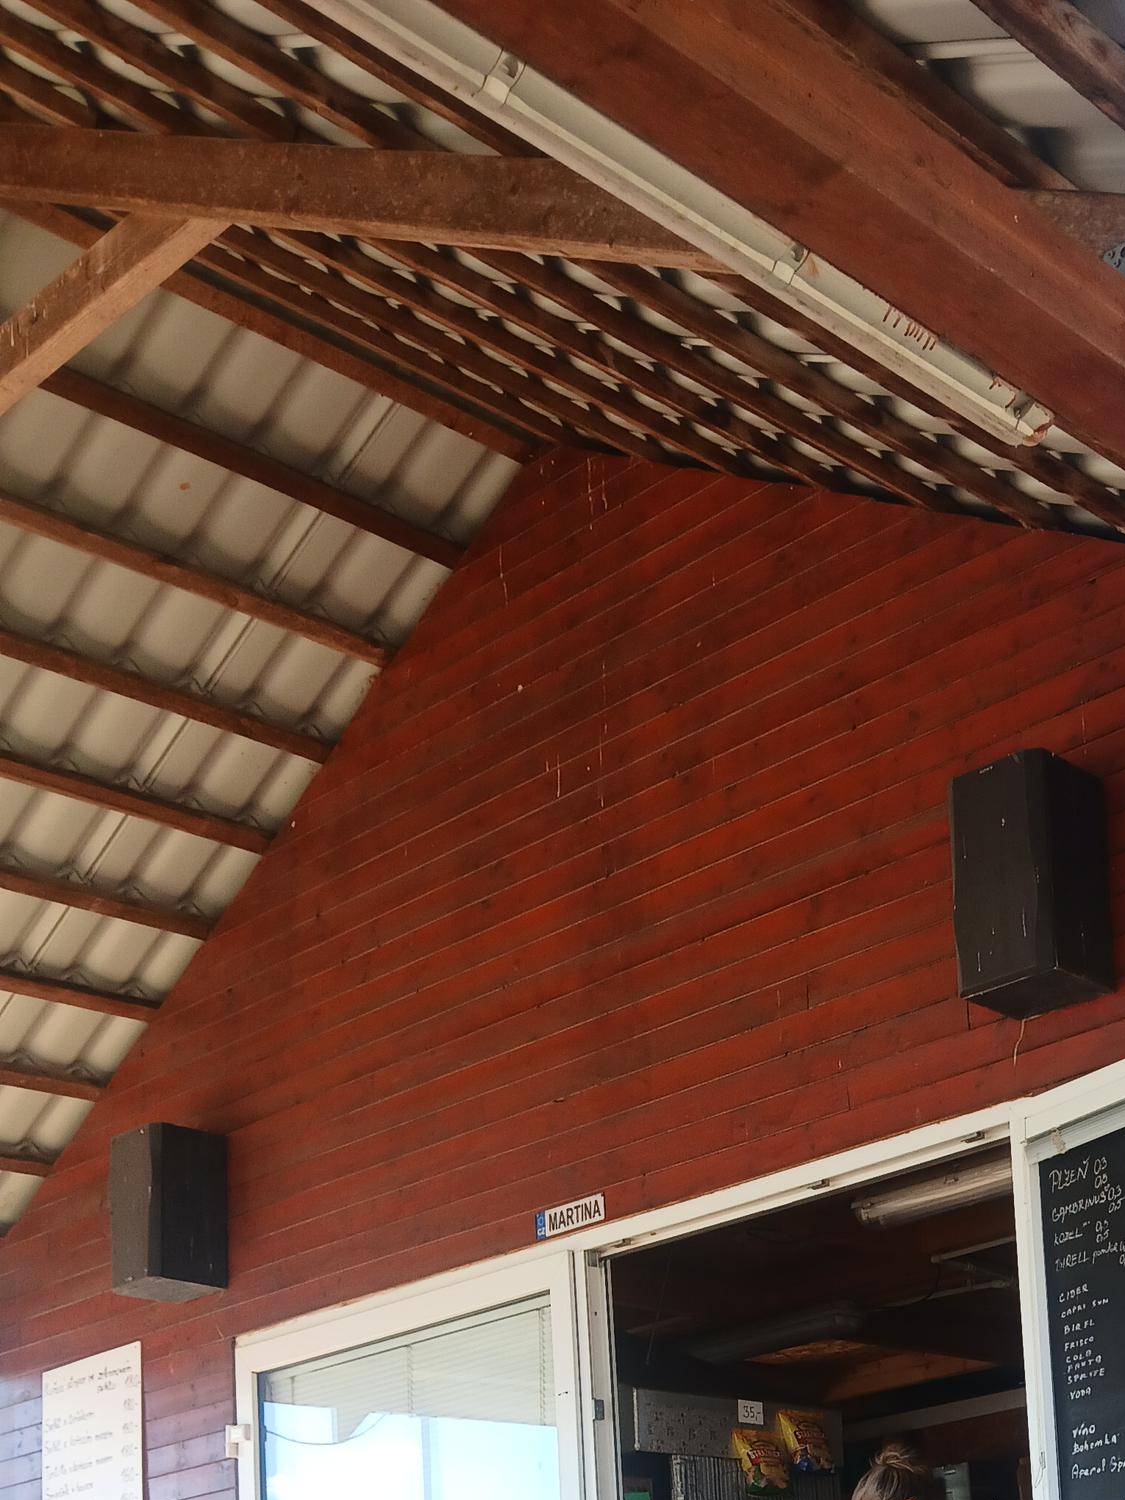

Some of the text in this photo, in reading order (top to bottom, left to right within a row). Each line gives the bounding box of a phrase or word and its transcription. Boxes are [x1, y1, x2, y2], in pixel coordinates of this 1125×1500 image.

[548, 1199, 602, 1232] MARTINA
[537, 1226, 546, 1236] CZ
[1059, 1283, 1089, 1303] CIDER
[1061, 1303, 1086, 1318] CAPRI
[1067, 1368, 1105, 1385] SPRITE
[1069, 1386, 1092, 1400] VODA
[1071, 1458, 1106, 1479] Aperol
